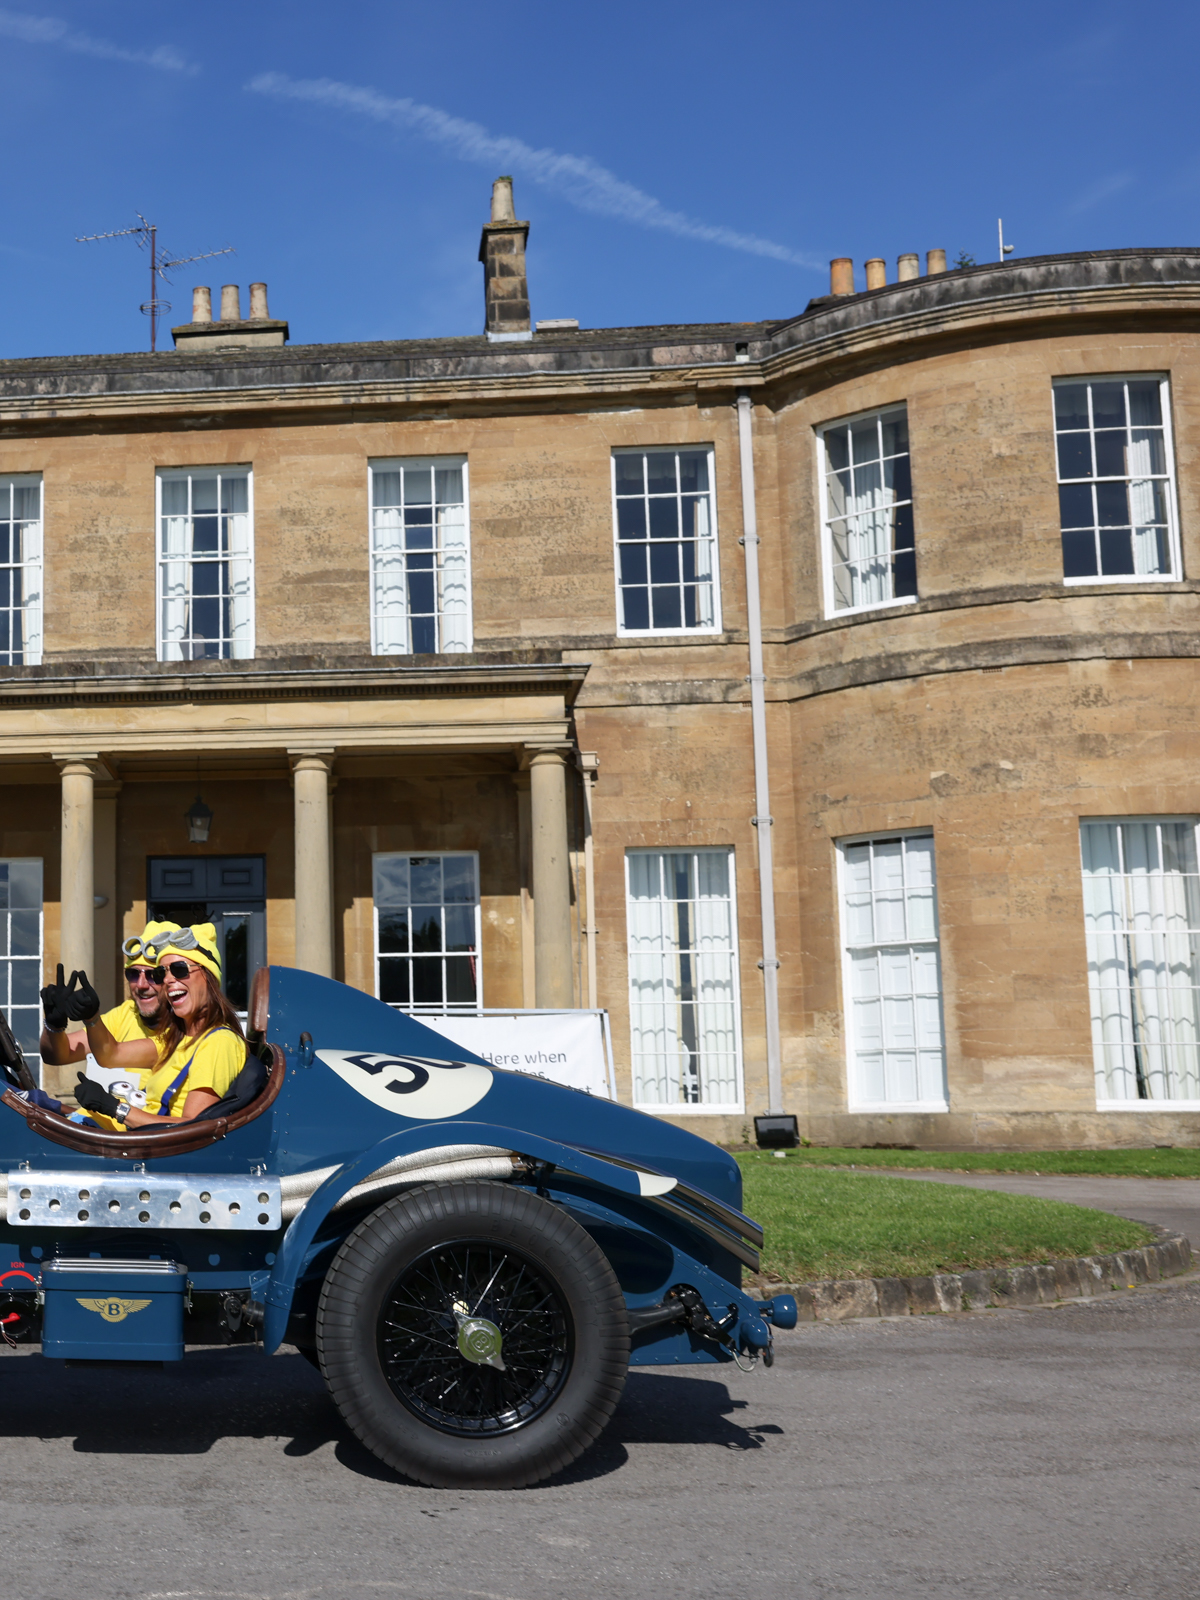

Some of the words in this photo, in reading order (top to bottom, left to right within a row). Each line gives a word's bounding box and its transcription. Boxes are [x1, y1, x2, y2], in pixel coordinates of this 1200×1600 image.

[481, 1053, 519, 1065] Here
[524, 1051, 567, 1064] when
[108, 1303, 121, 1316] B
